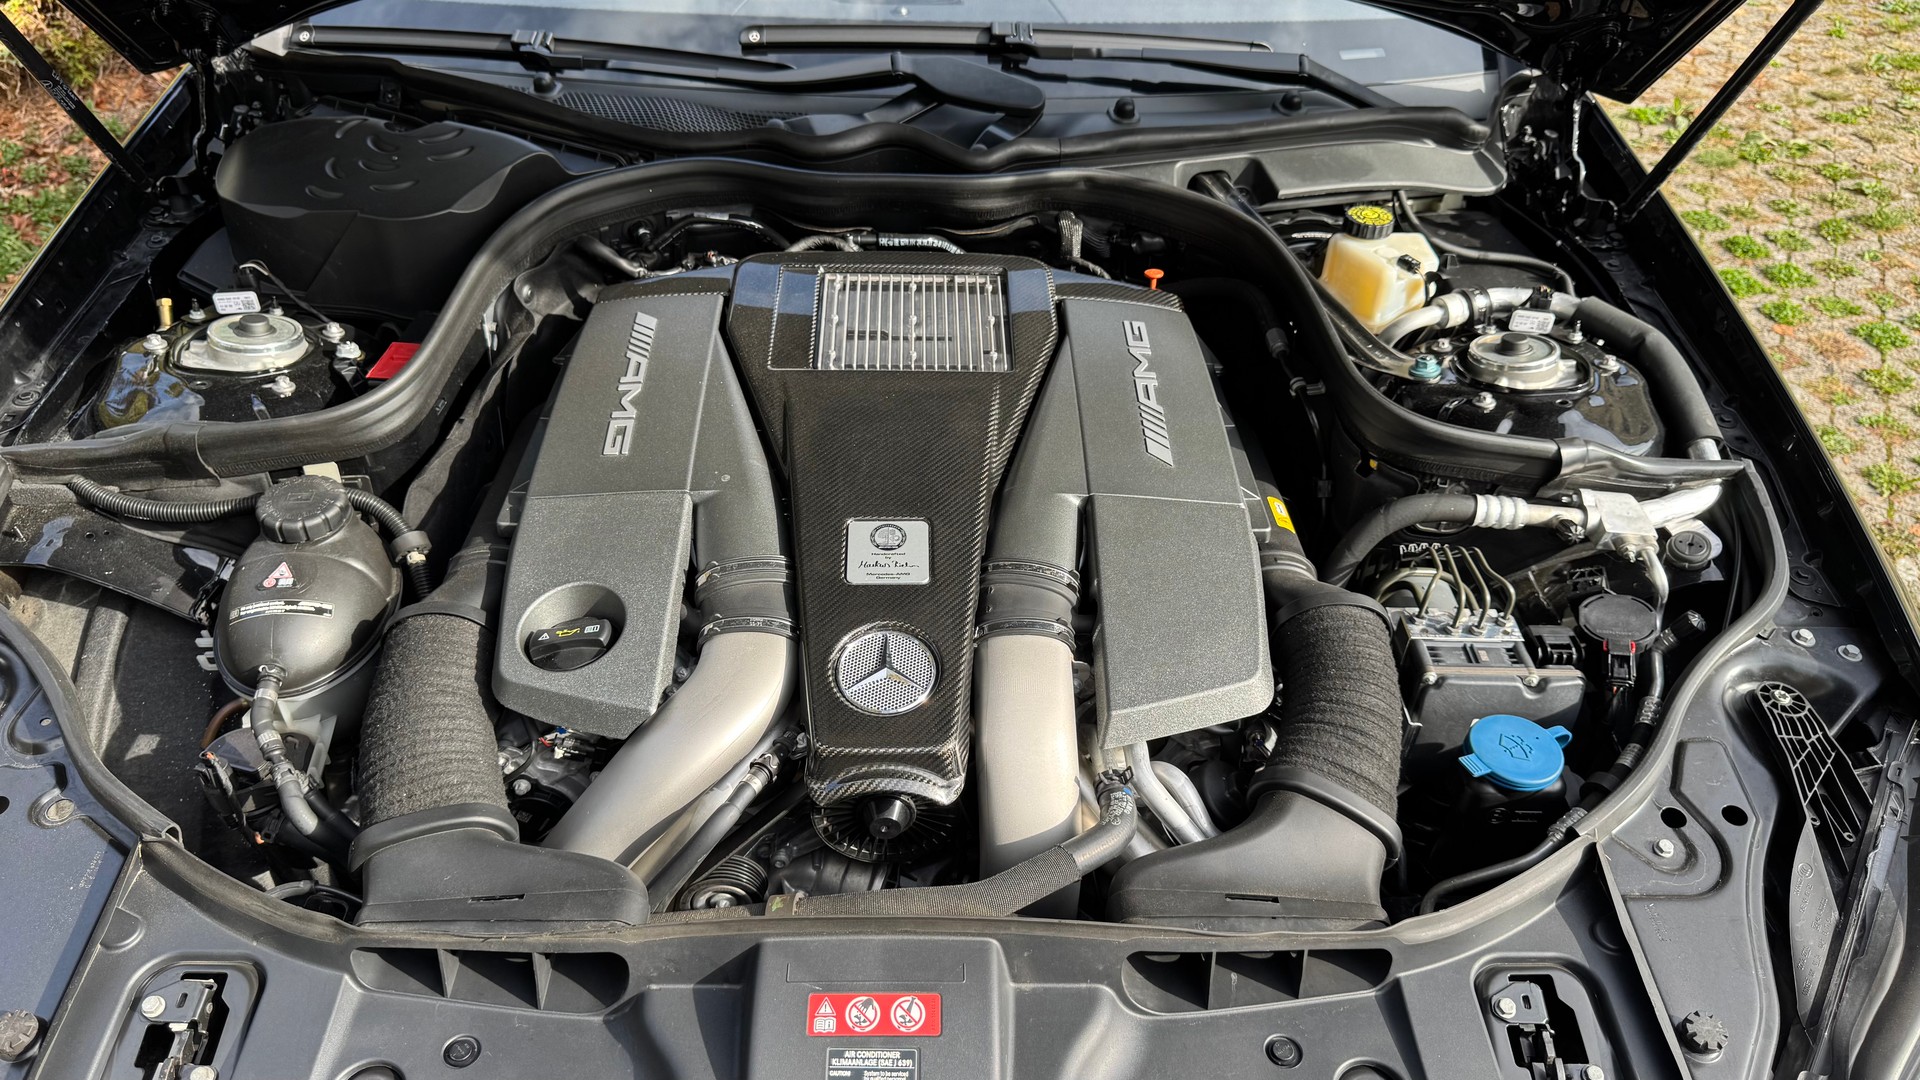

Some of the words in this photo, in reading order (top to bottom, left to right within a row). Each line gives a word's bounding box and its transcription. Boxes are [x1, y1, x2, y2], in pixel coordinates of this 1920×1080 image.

[1122, 320, 1164, 415] AMG
[602, 350, 649, 456] AMG
[831, 1058, 878, 1066] KLIMAANLAGE
[878, 1058, 893, 1067] (SAE
[897, 1059, 913, 1067] 639)
[844, 1050, 856, 1058] AIR
[856, 1051, 900, 1059] CONDITIONER
